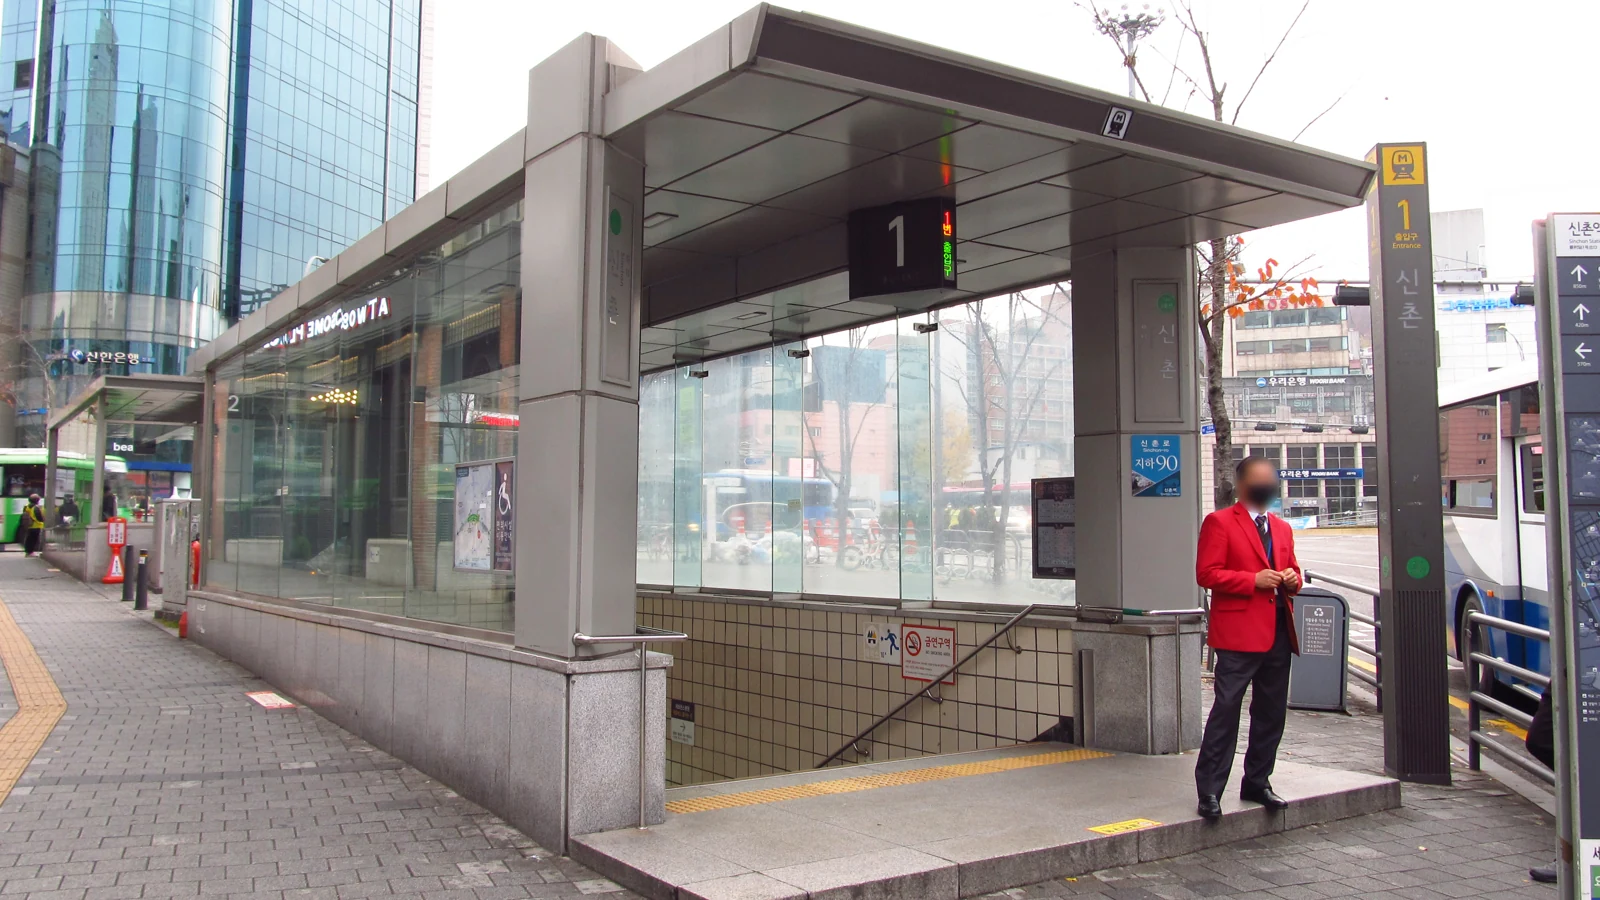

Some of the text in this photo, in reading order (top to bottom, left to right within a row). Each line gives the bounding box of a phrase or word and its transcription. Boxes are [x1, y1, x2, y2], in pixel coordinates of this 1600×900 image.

[1397, 199, 1411, 230] 1
[888, 215, 905, 268] 1
[1392, 242, 1422, 250] Entrance
[1396, 268, 1423, 330] 신촌
[86, 351, 139, 365] 신한은행
[1158, 323, 1177, 379] 신촌
[1268, 376, 1307, 387] 우리은행
[228, 394, 239, 412] 2
[1279, 470, 1310, 478] 우리은행
[925, 636, 951, 649] 금연구역
